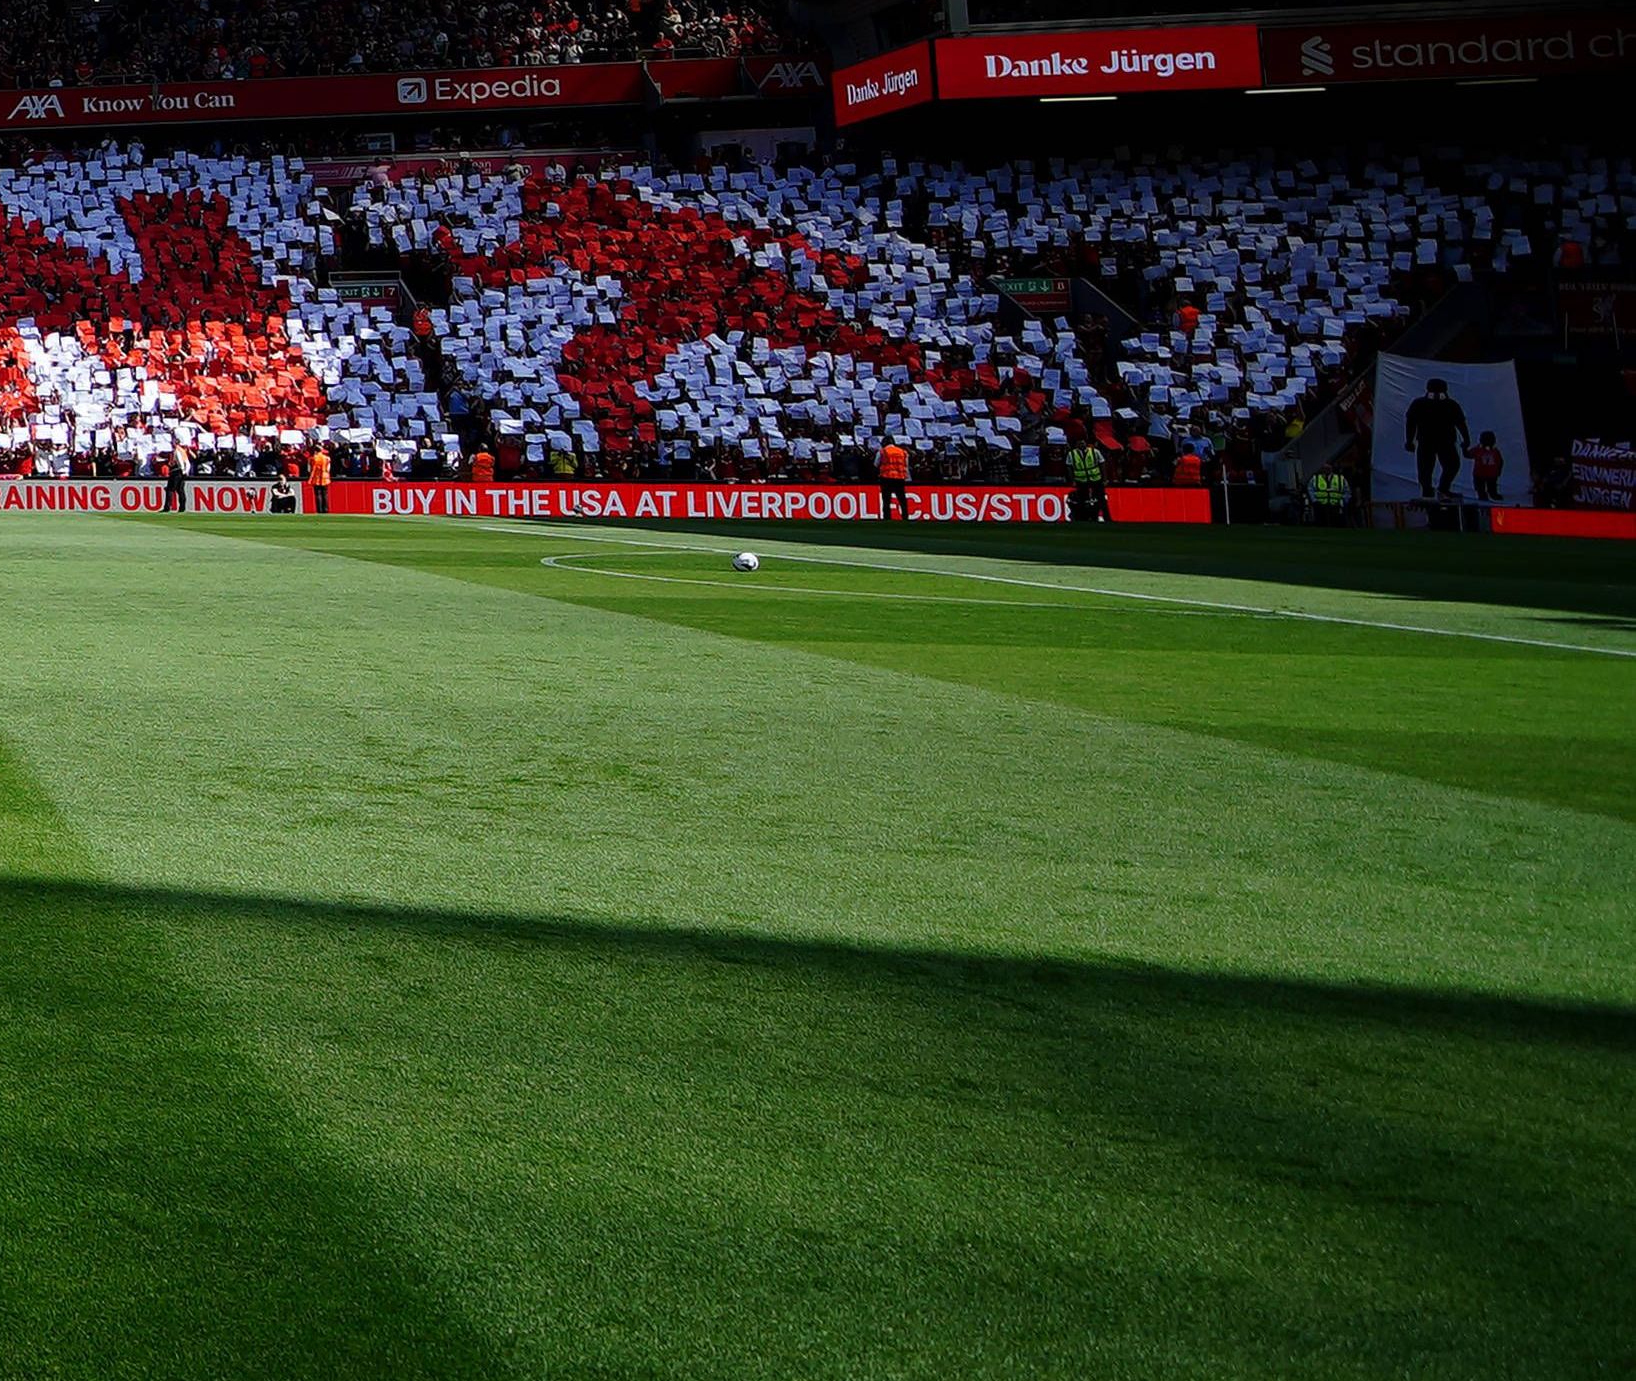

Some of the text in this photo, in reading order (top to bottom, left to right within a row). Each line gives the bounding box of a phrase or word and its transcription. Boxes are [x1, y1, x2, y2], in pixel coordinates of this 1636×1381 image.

[984, 48, 1216, 78] Danke Jürgen
[1351, 29, 1576, 69] standard
[759, 61, 824, 88] AXA
[846, 67, 918, 106] Danke Jürgen
[434, 76, 561, 104] Expedia
[7, 92, 236, 120] AXA Know You Can
[388, 287, 396, 296] 7
[193, 486, 267, 512] NOW
[372, 489, 435, 515] BUY
[445, 489, 477, 515] IN
[485, 489, 551, 516] THE
[559, 490, 627, 517] USA
[635, 491, 678, 517] AT
